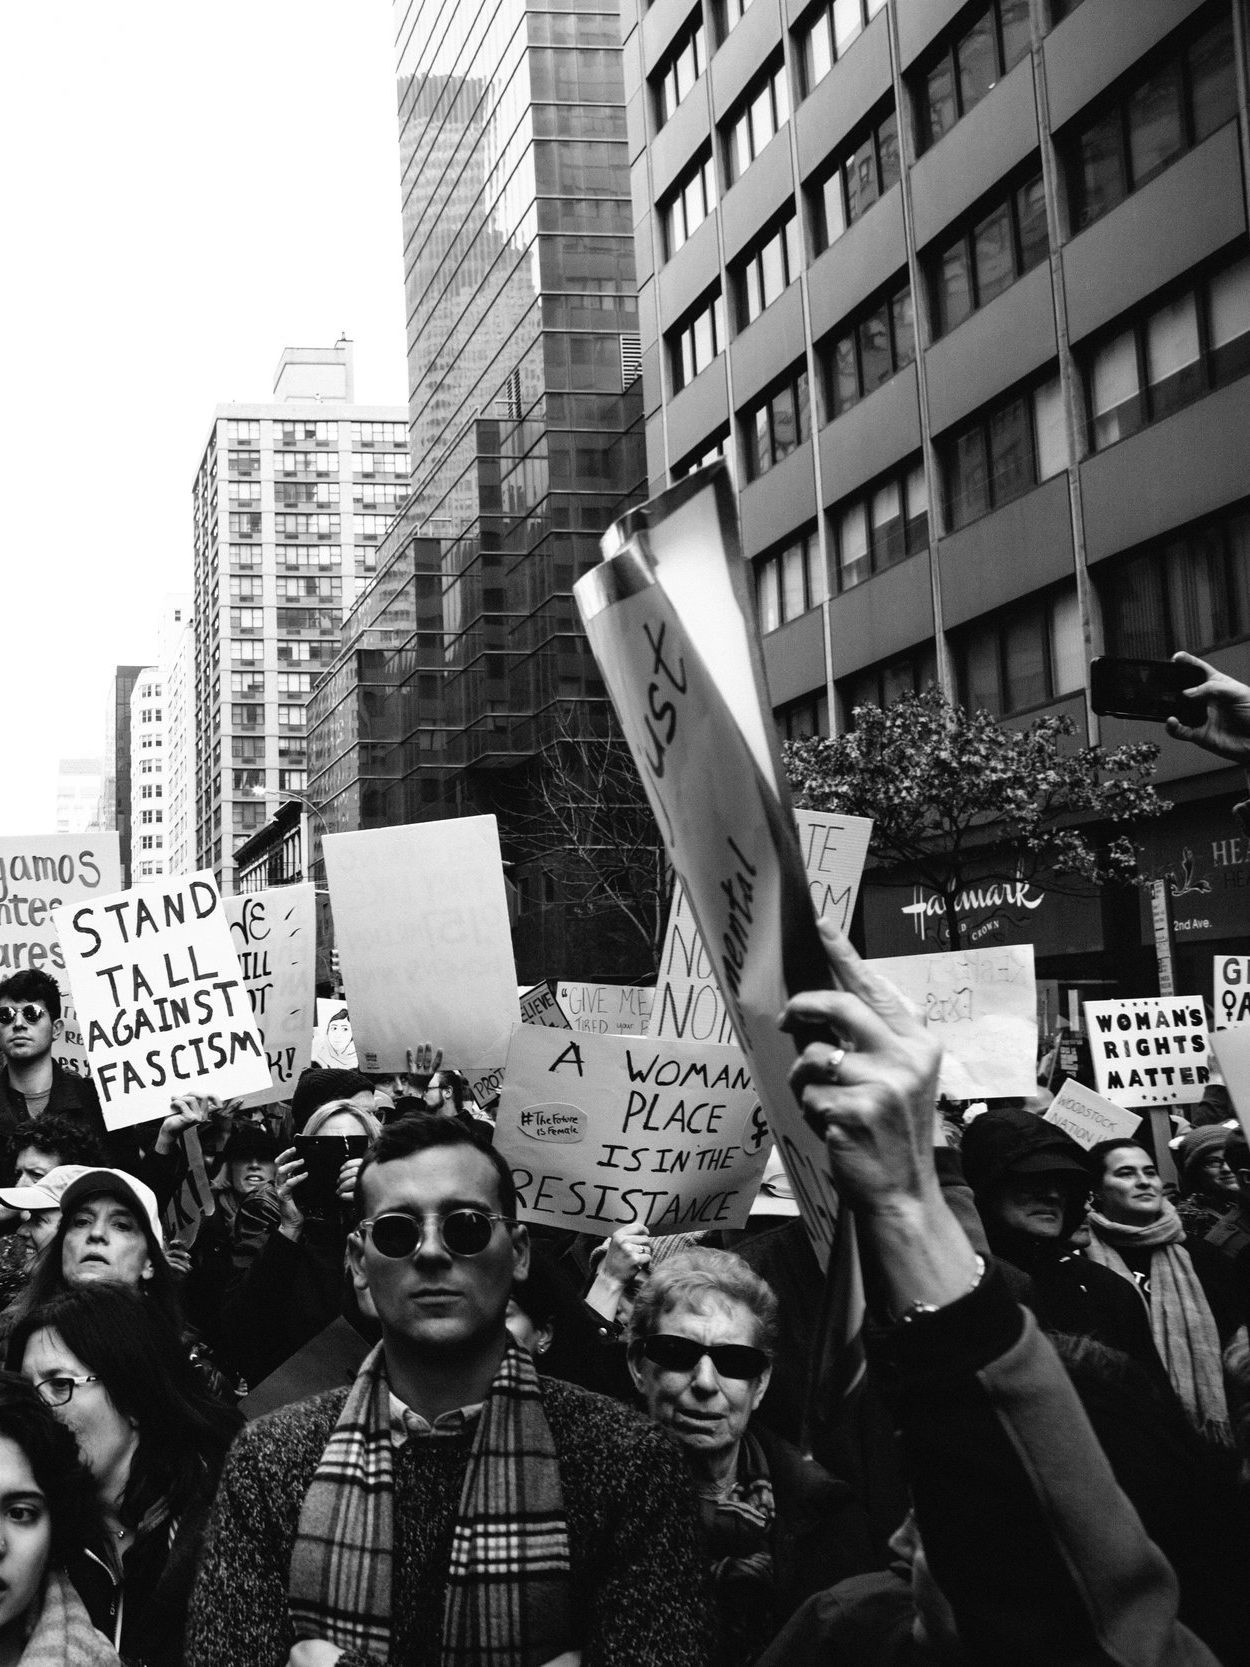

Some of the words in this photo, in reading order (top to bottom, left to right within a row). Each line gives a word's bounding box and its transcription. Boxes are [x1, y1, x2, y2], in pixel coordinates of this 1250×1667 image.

[799, 823, 845, 872] TE
[900, 856, 1045, 941] Hamark
[71, 880, 218, 958] STAND
[971, 919, 999, 942] CROWN
[1173, 919, 1190, 931] 2nd
[1192, 918, 1212, 930] Ave.
[96, 945, 219, 1009] TALL
[237, 950, 272, 981] ILL
[86, 980, 239, 1053] AGAINST
[520, 991, 555, 1024] ELIEVE
[1095, 1004, 1204, 1033] WOMAN'S
[575, 1017, 609, 1034] TIRED
[1103, 1034, 1206, 1059] RIGHTS
[98, 1028, 263, 1103] FASCISM
[548, 1040, 584, 1077] A
[626, 1050, 756, 1090] WOMAN
[1108, 1065, 1210, 1090] MATTER
[473, 1066, 506, 1100] PROT
[622, 1090, 726, 1134] PLACE
[1051, 1112, 1095, 1143] NATION
[1057, 1095, 1119, 1133] WOODSTOCK
[597, 1144, 649, 1172] IS
[650, 1149, 691, 1174] IN
[695, 1145, 741, 1171] THE
[511, 1168, 740, 1228] RESISTANCE
